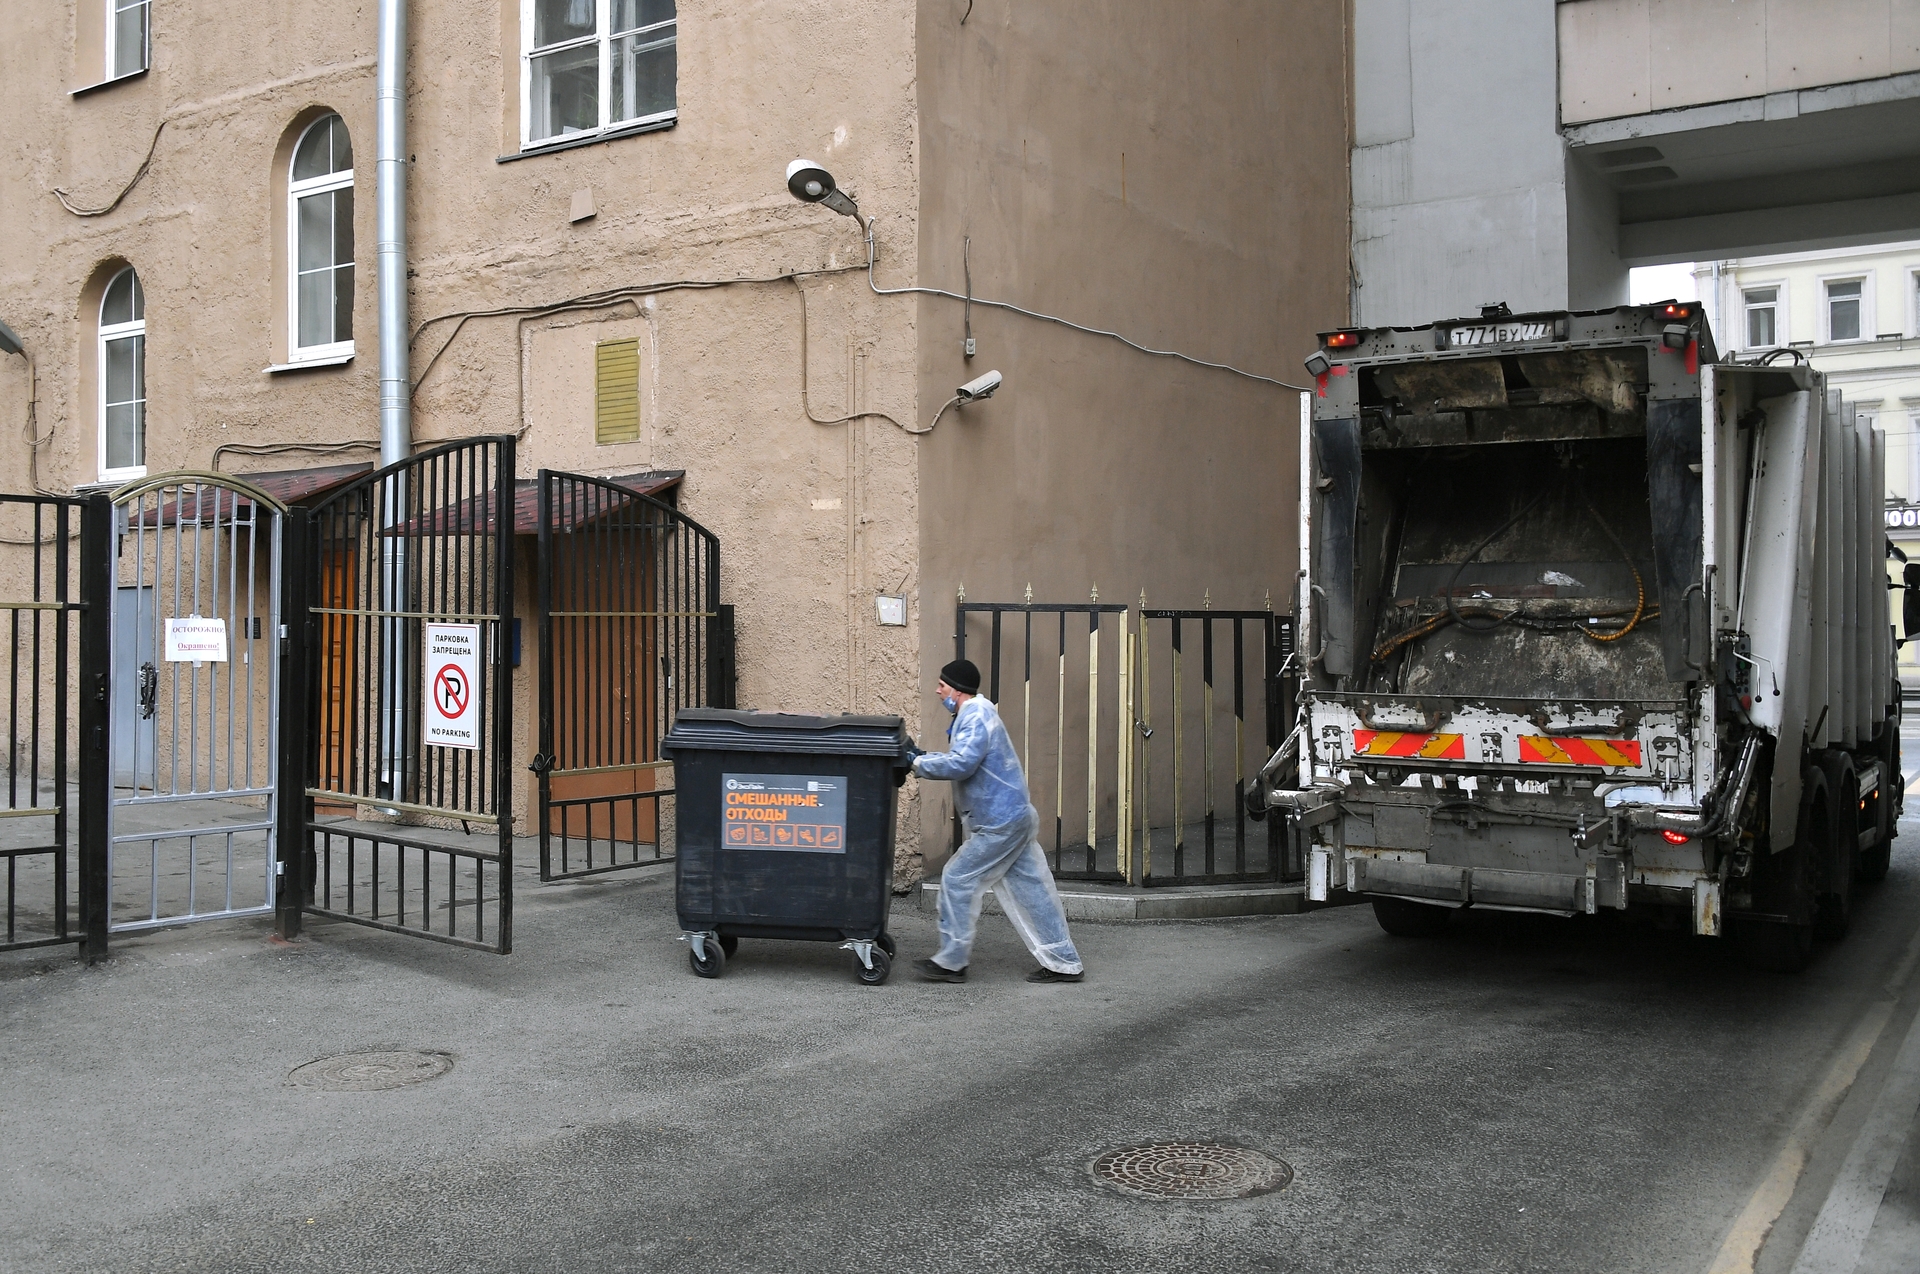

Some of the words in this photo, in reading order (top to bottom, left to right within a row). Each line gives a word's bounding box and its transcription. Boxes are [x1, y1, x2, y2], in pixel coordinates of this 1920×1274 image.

[1523, 323, 1548, 335] 777
[435, 634, 469, 643] ПАРКОВКА
[432, 646, 472, 656] ЗАПРЕЩЕНА
[442, 728, 471, 738] PARKING
[726, 792, 819, 807] СМЕШАННЫЕ
[726, 807, 787, 822] ОТХОДЫ
